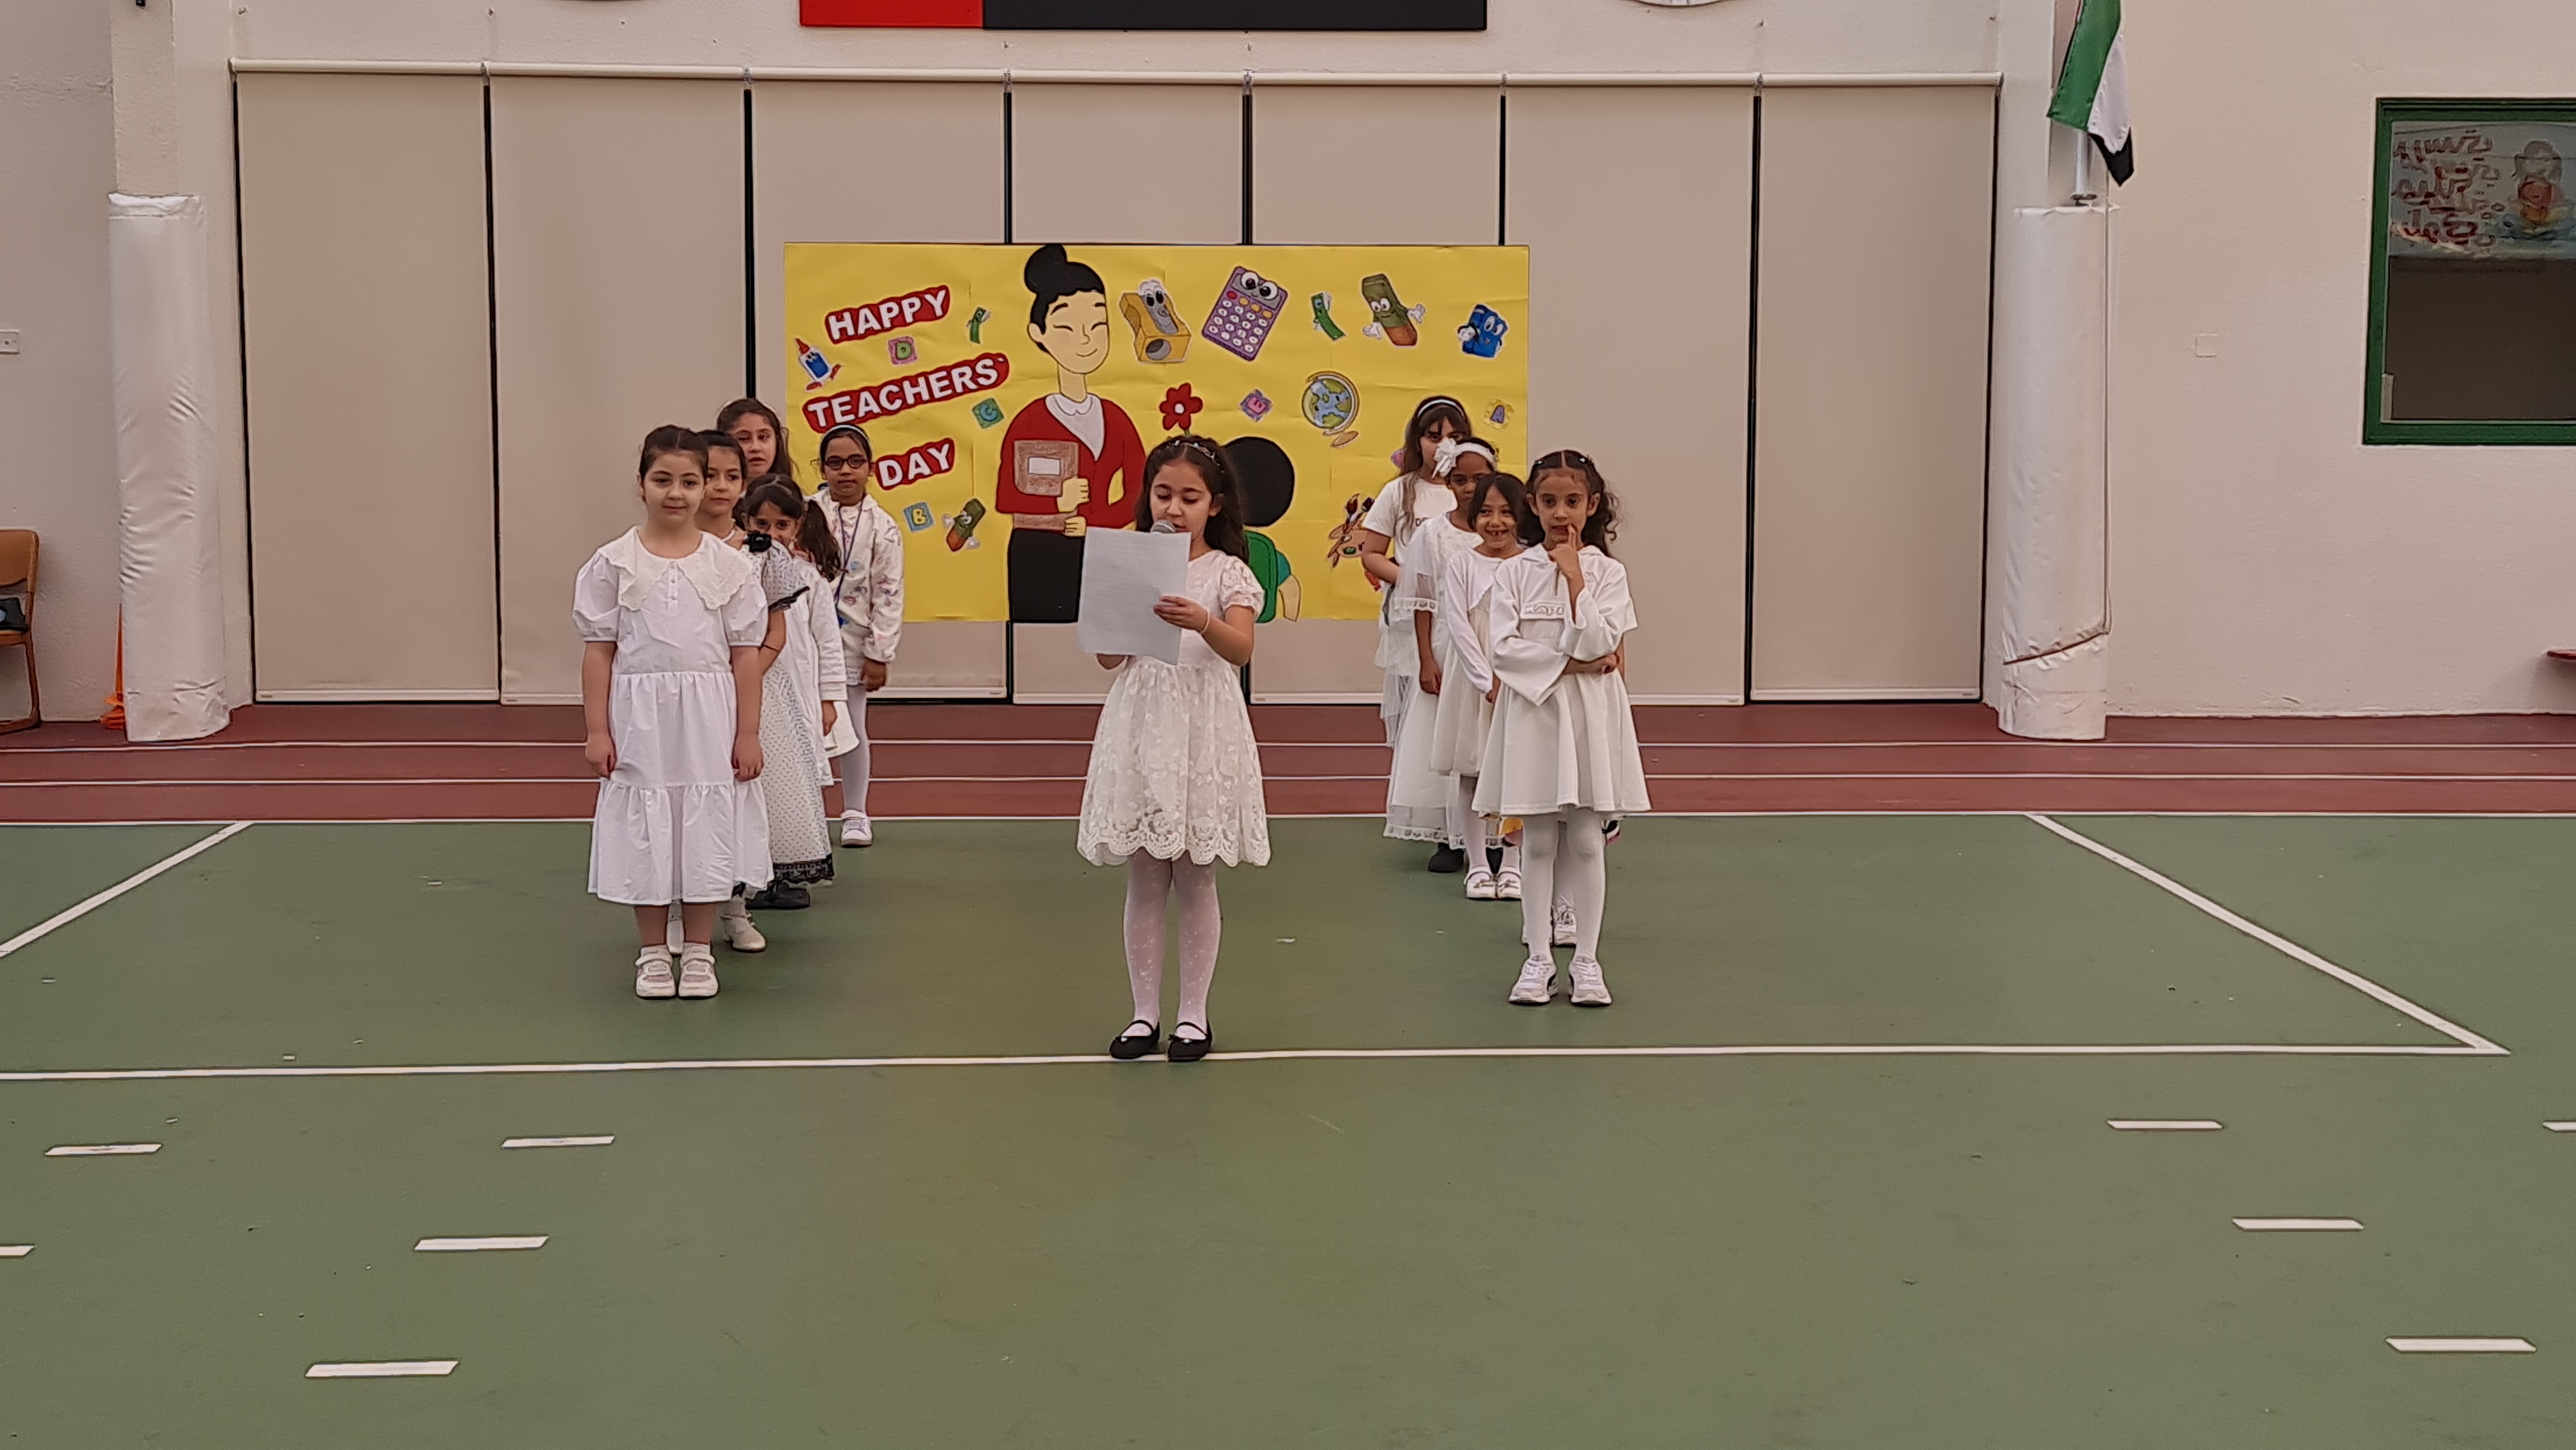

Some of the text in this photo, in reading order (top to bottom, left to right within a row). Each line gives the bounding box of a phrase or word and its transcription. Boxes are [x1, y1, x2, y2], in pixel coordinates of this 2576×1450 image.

[828, 290, 946, 341] HAPPY
[896, 341, 912, 360] D
[980, 402, 998, 422] C
[1490, 404, 1505, 424] A
[878, 443, 950, 487] DAY
[911, 507, 928, 525] B
